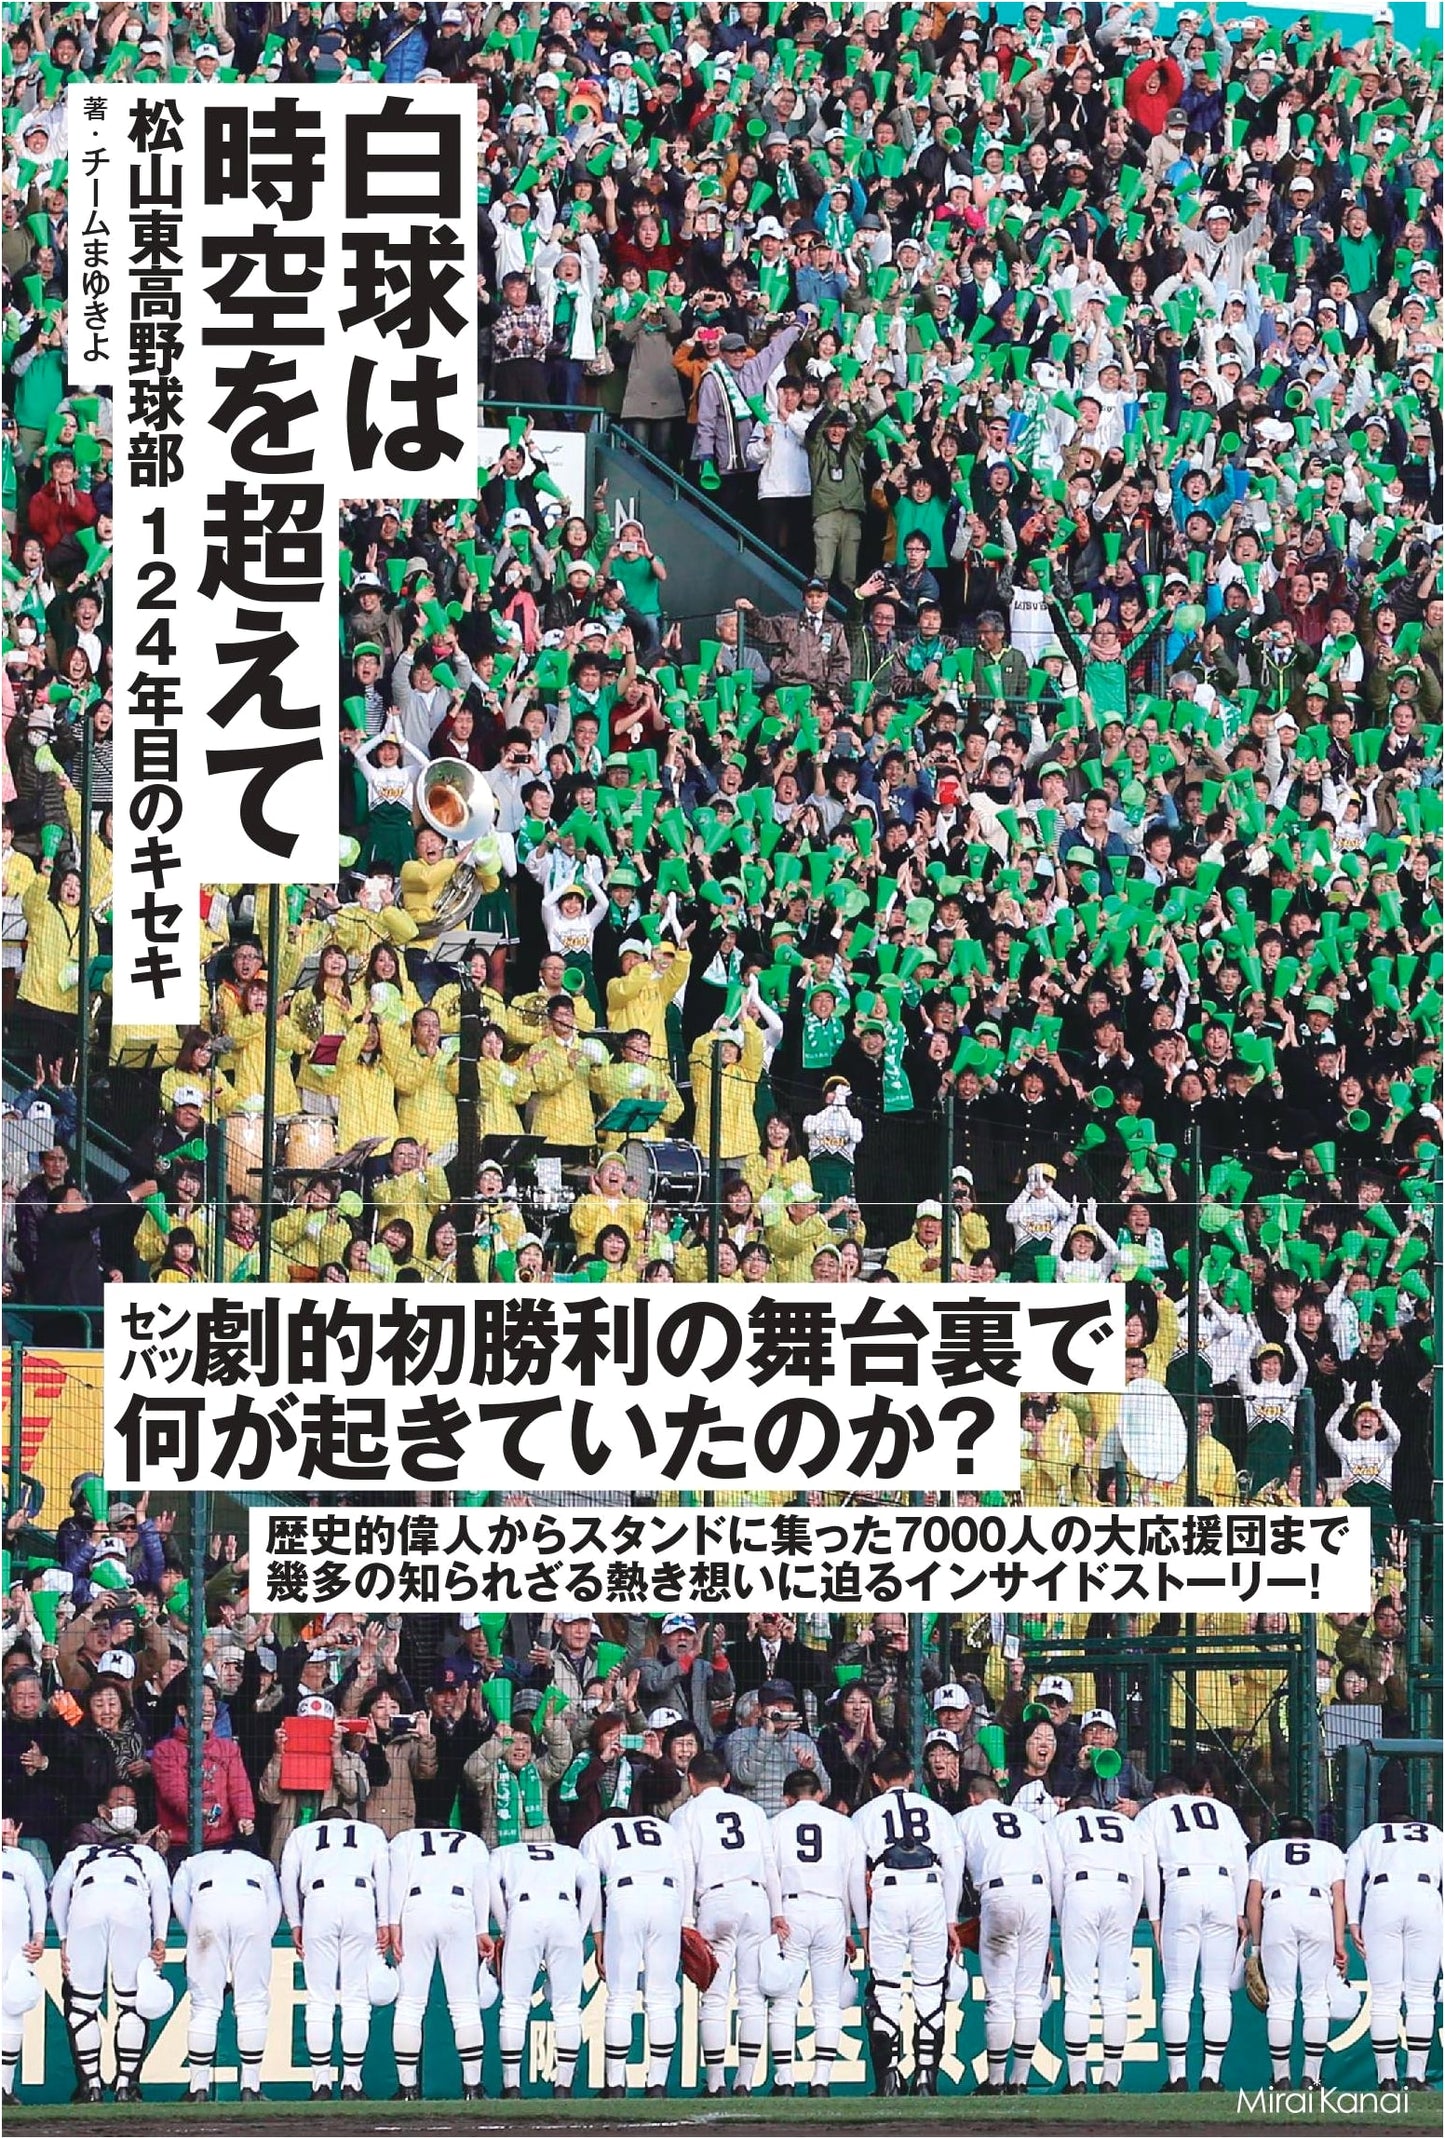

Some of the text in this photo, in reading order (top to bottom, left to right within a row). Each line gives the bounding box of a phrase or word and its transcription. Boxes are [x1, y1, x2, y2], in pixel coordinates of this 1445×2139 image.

[716, 1812, 744, 1849] 3
[882, 1808, 931, 1845] 18
[993, 1812, 1021, 1839] 8
[1078, 1815, 1124, 1843] 15
[1170, 1802, 1220, 1833] 10
[315, 1825, 358, 1851] 11
[420, 1831, 467, 1857] 17
[611, 1820, 662, 1850] 16
[796, 1824, 822, 1862] 9
[1381, 1822, 1429, 1844] 13
[527, 1845, 555, 1861] 5
[1284, 1843, 1311, 1865] 6
